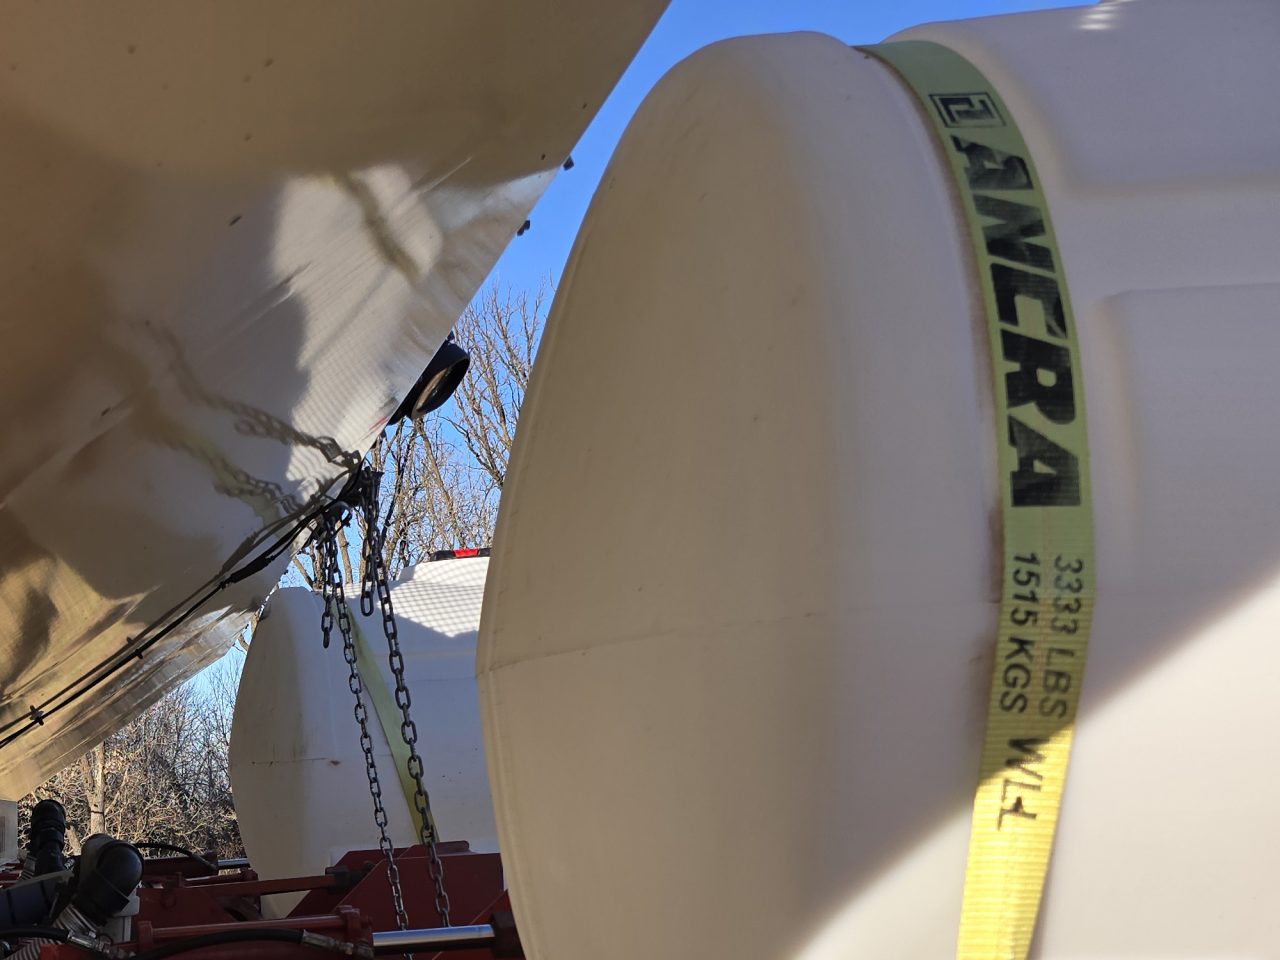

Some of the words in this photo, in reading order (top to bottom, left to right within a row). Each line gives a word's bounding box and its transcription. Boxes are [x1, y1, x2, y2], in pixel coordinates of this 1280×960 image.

[950, 134, 1082, 507] ANCRA
[1010, 552, 1041, 627] 1515
[1052, 554, 1083, 635] 3333
[999, 636, 1035, 714] KGS
[1038, 647, 1075, 719] LBS
[998, 737, 1050, 831] WLL
